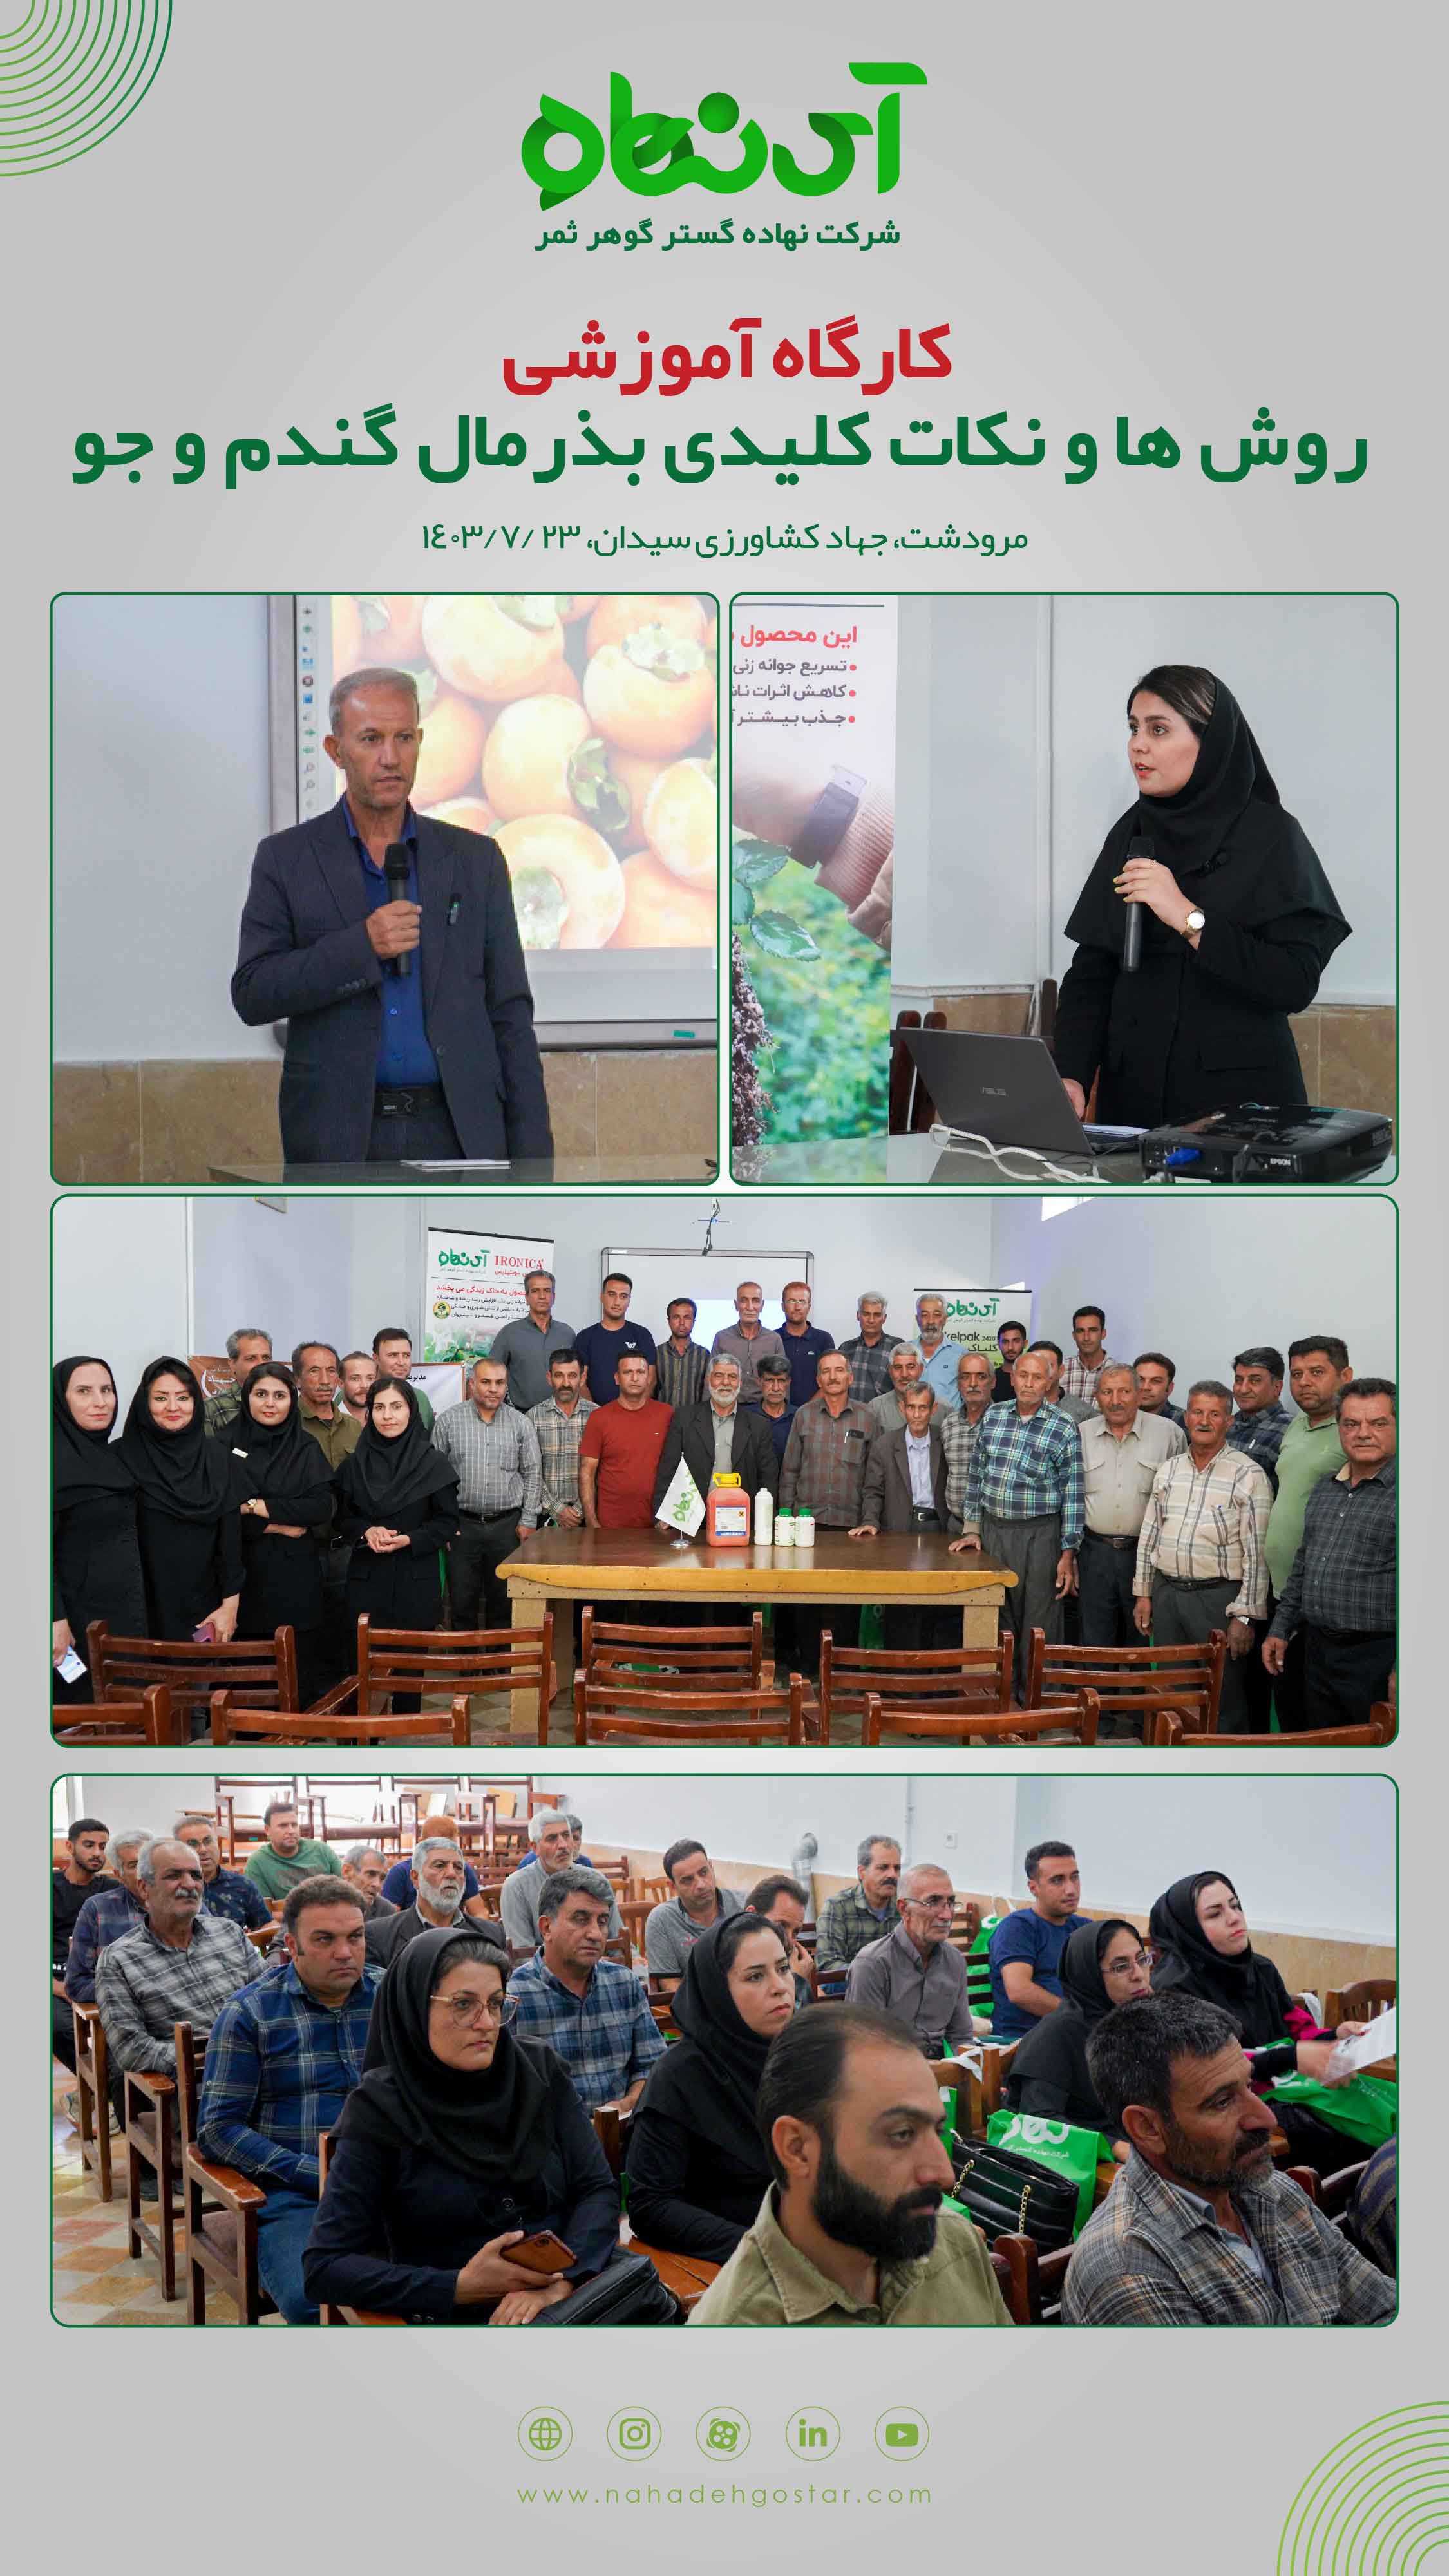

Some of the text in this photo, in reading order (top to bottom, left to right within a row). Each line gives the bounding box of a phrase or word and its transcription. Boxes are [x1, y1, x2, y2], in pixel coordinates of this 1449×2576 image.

[741, 624, 817, 647] محصول
[823, 625, 857, 649] این
[733, 658, 847, 676] تسریع جوانه زنی
[752, 683, 790, 701] اثرات
[793, 684, 847, 701] کاهش
[737, 710, 799, 727] بیشتر
[802, 710, 846, 727] جذب
[1270, 1158, 1291, 1166] EPSON
[494, 1255, 544, 1270] IRONICA
